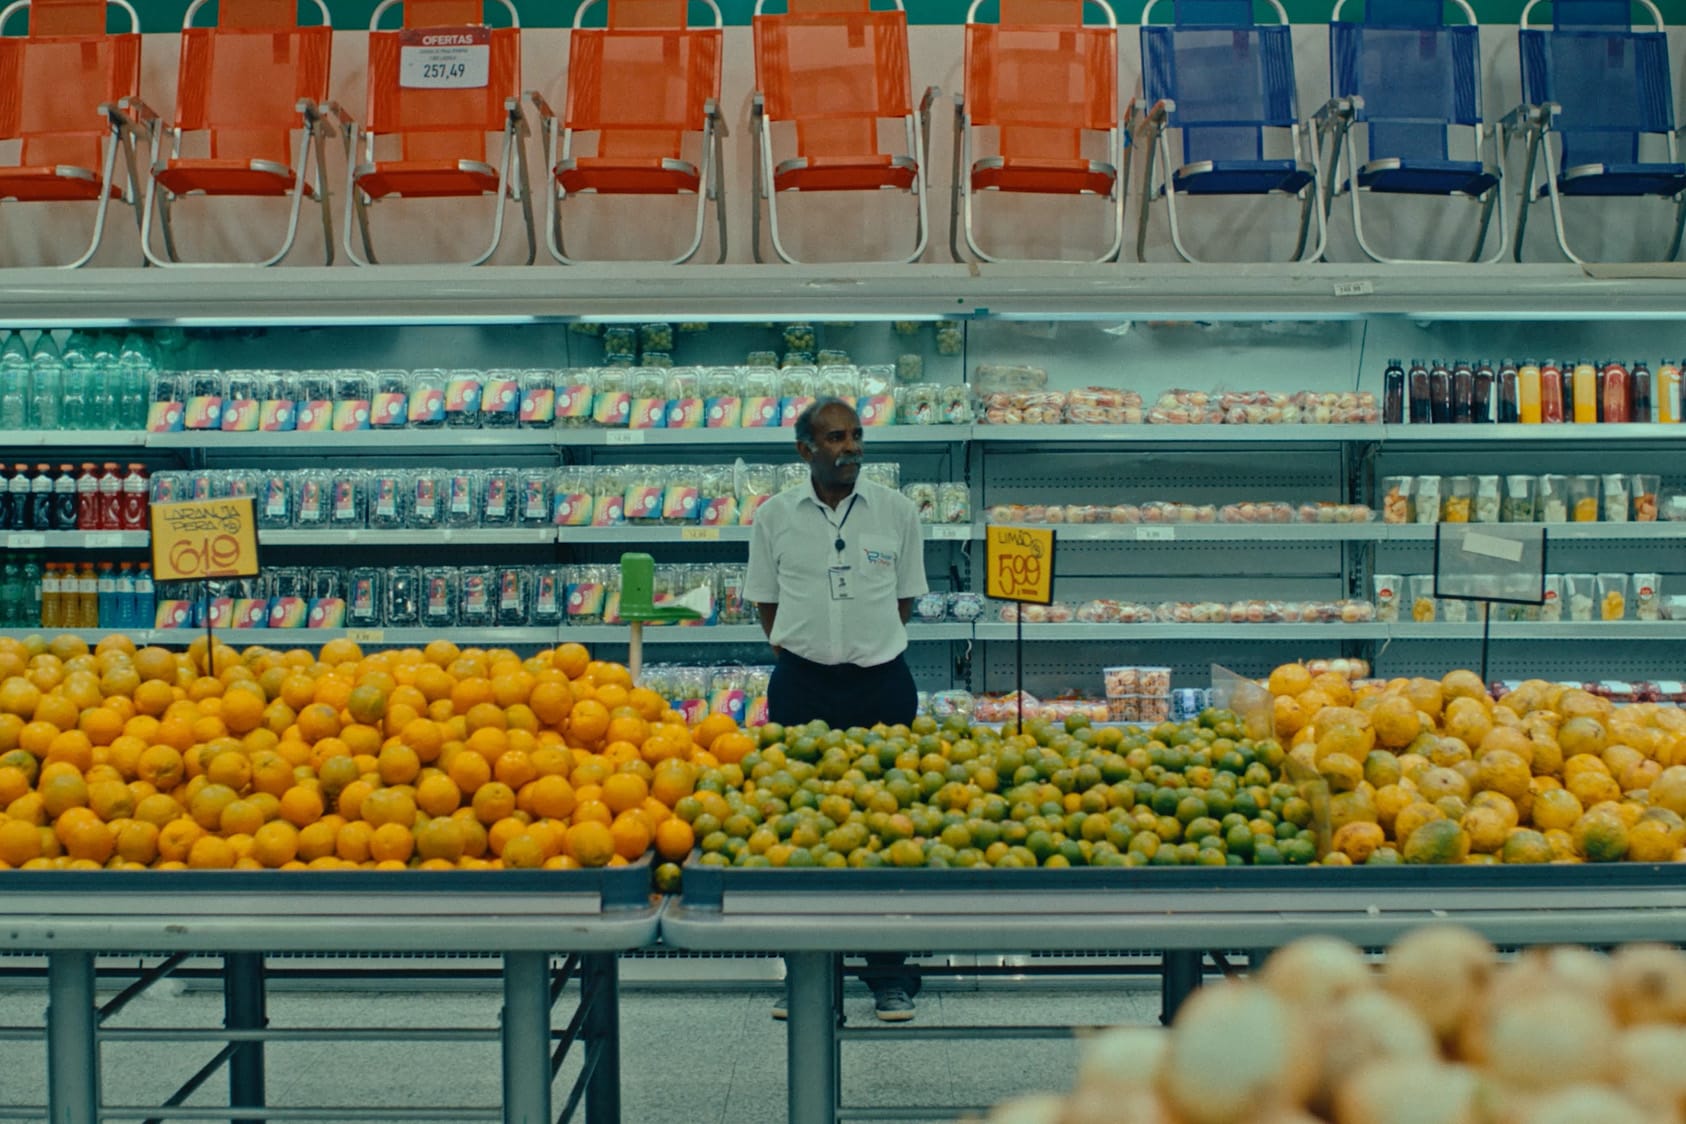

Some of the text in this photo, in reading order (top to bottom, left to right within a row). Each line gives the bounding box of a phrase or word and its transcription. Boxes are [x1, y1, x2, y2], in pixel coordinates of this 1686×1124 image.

[422, 34, 473, 45] OFERTAS
[424, 63, 465, 80] 257,49
[162, 505, 241, 521] LARANJA
[171, 520, 218, 531] PERA
